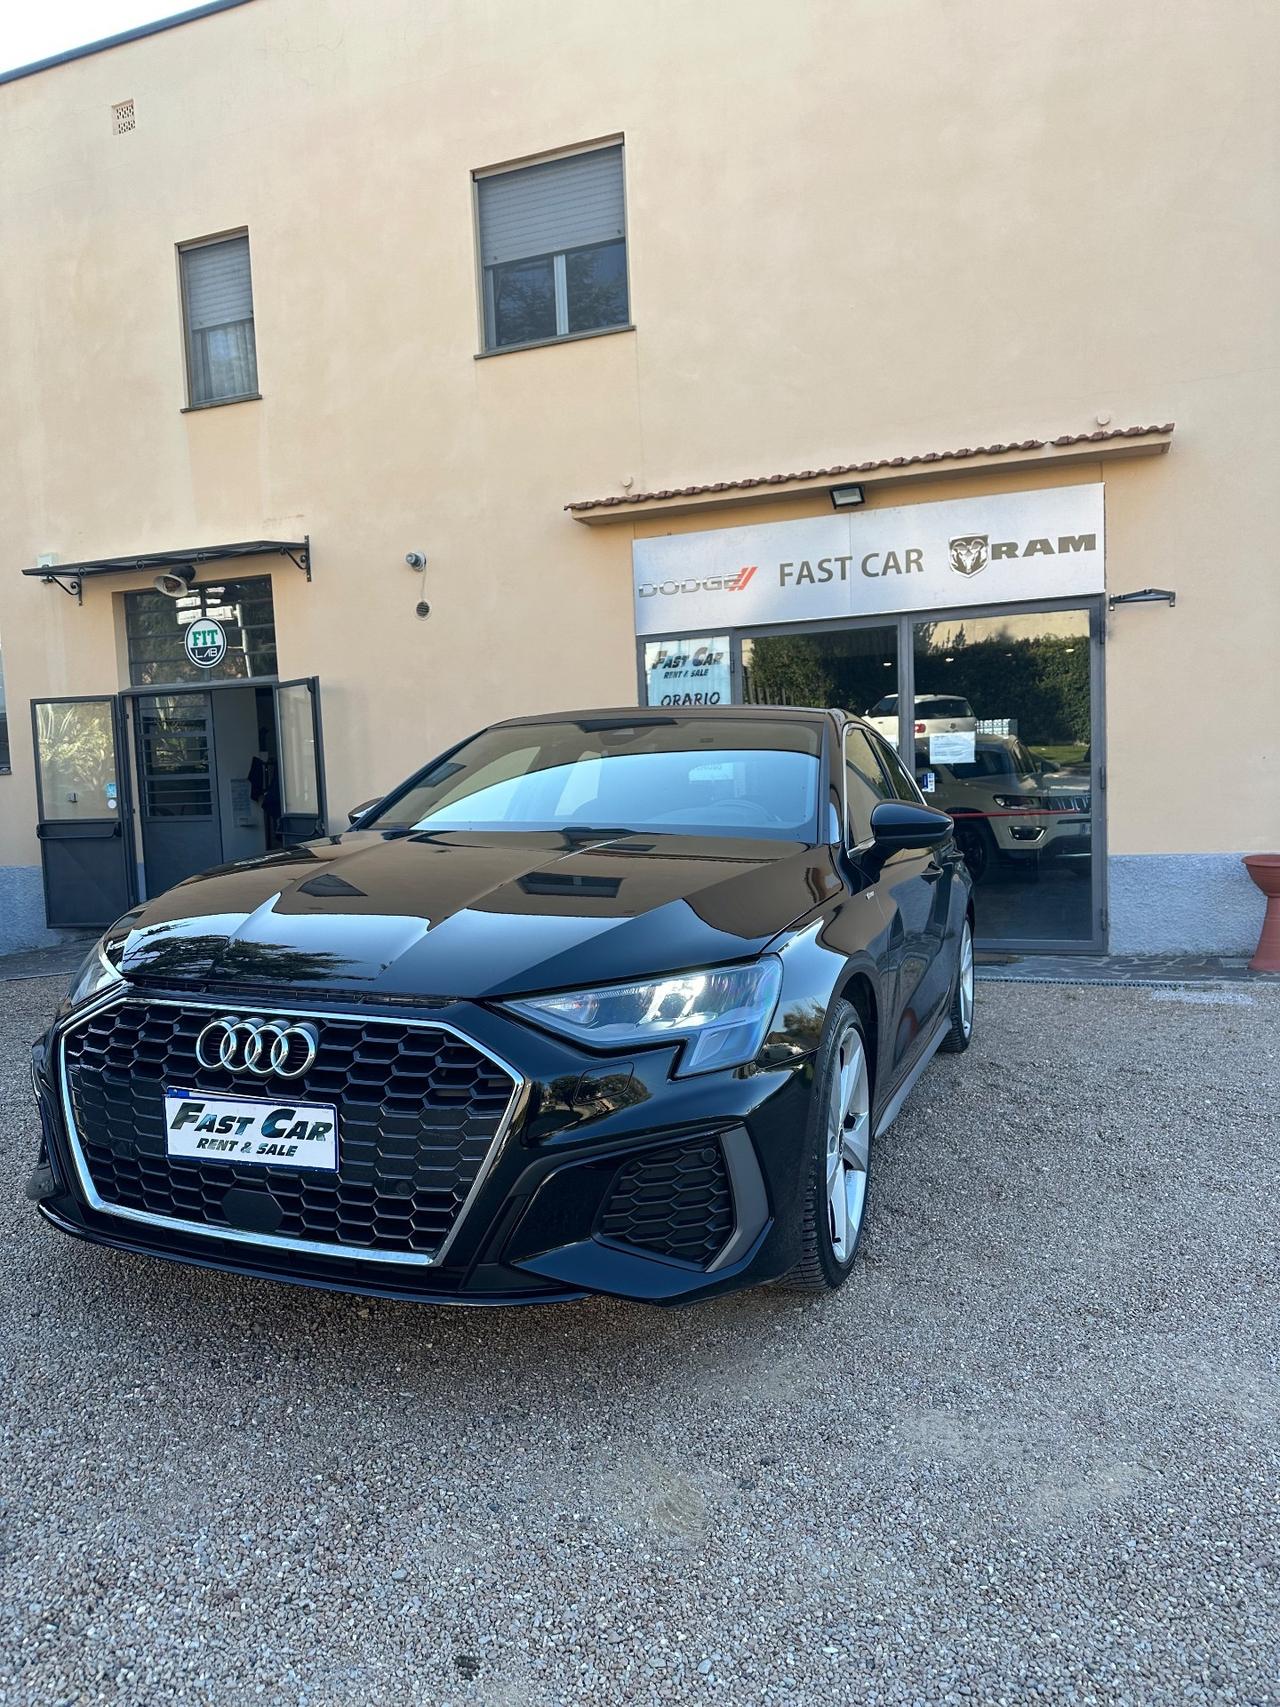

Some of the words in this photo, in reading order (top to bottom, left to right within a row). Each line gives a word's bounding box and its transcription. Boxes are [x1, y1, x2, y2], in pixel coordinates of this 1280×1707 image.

[991, 533, 1097, 560] RAM
[779, 556, 853, 587] FAST
[861, 548, 924, 578] CAR
[638, 573, 742, 598] DODGE
[192, 629, 218, 646] FIT
[195, 647, 218, 658] LAB
[652, 650, 690, 669] FAST
[692, 646, 724, 667] CAR
[663, 670, 683, 680] RENT
[690, 668, 709, 677] SALE
[660, 691, 720, 706] ORARIO
[170, 1102, 255, 1136] FAST
[260, 1108, 333, 1142] CAR
[196, 1137, 239, 1152] RENT
[240, 1142, 252, 1154] &
[256, 1142, 298, 1157] SALE
